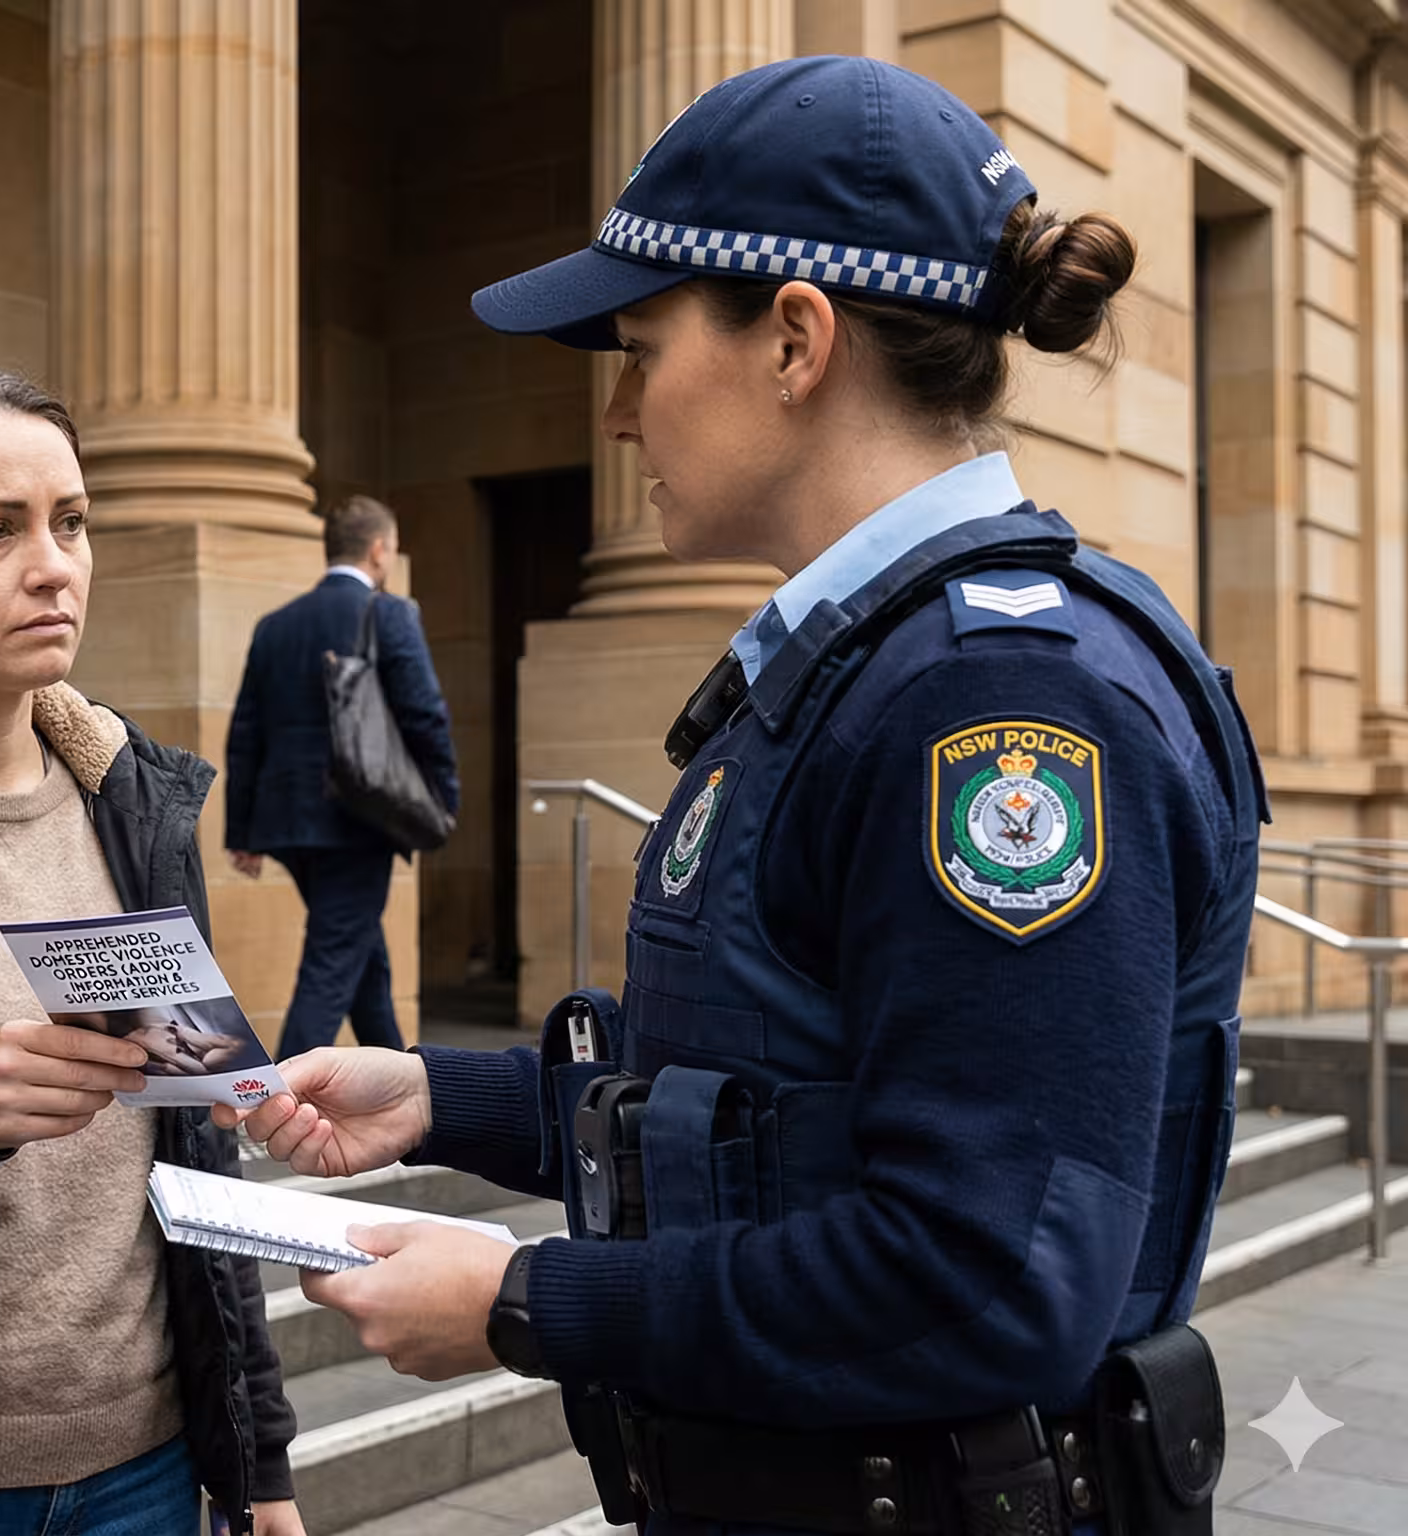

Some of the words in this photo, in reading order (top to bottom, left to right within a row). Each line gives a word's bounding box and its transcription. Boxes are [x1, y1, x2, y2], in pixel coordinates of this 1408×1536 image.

[943, 732, 997, 764] NSW
[1004, 730, 1090, 768] POLICE
[45, 932, 161, 953] APPREHENDED
[29, 951, 111, 969] DOMESTIC
[111, 941, 197, 962] VIOLENCE
[53, 963, 118, 981] ORDERS
[121, 958, 182, 976] (ADVO)
[64, 989, 128, 1005] SUPPORT
[130, 982, 201, 999] SERVICES
[69, 973, 170, 993] INFORMATION
